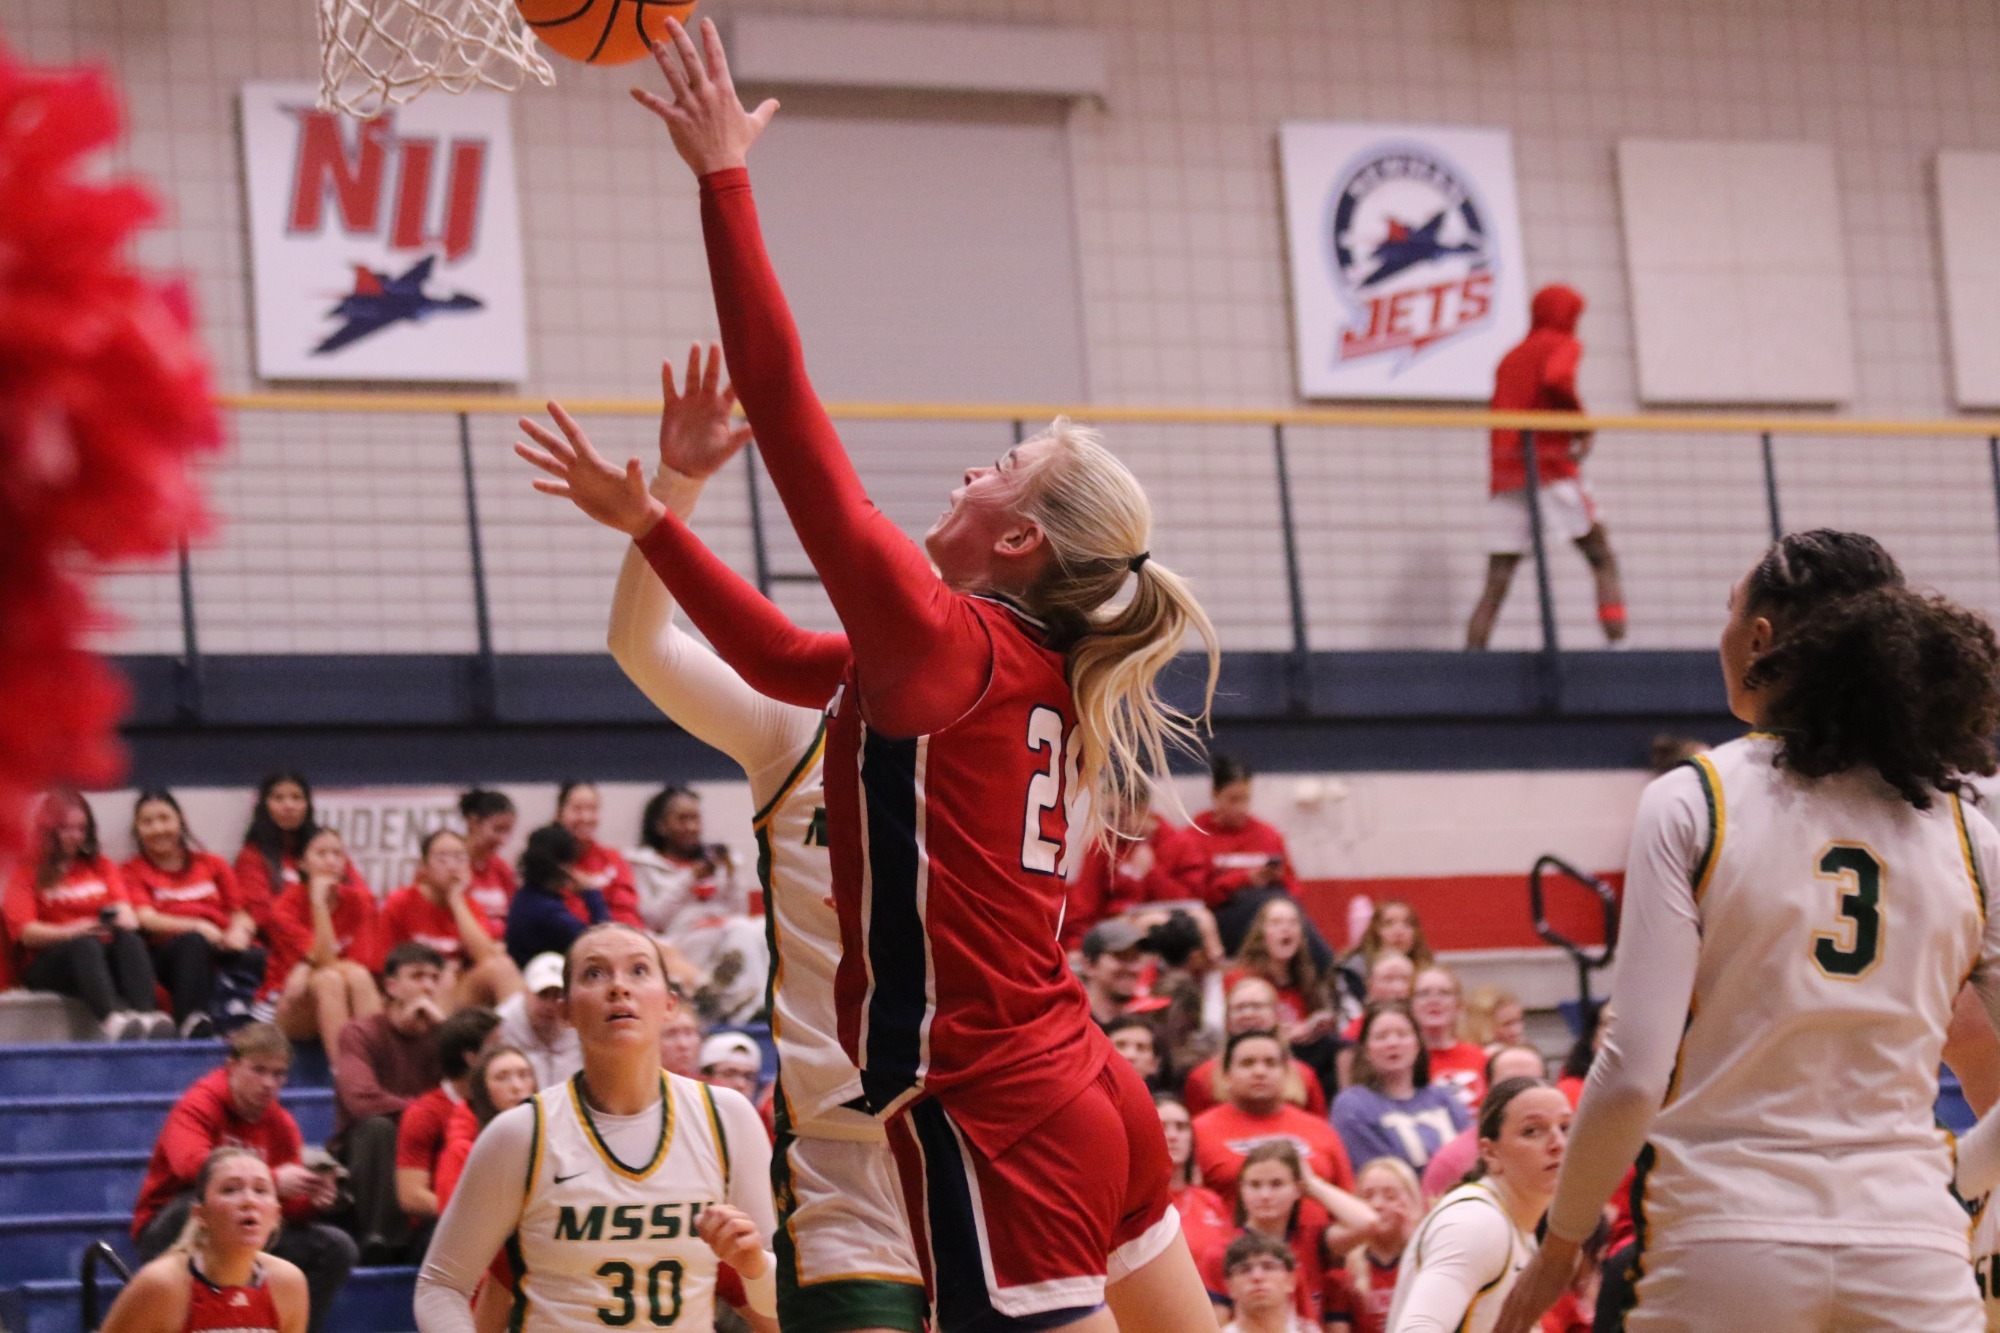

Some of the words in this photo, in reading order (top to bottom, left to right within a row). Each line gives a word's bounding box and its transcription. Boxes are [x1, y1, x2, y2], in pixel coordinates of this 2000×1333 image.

[1343, 273, 1495, 348] JETS
[1809, 840, 1887, 981] 3
[594, 1257, 686, 1328] 30
